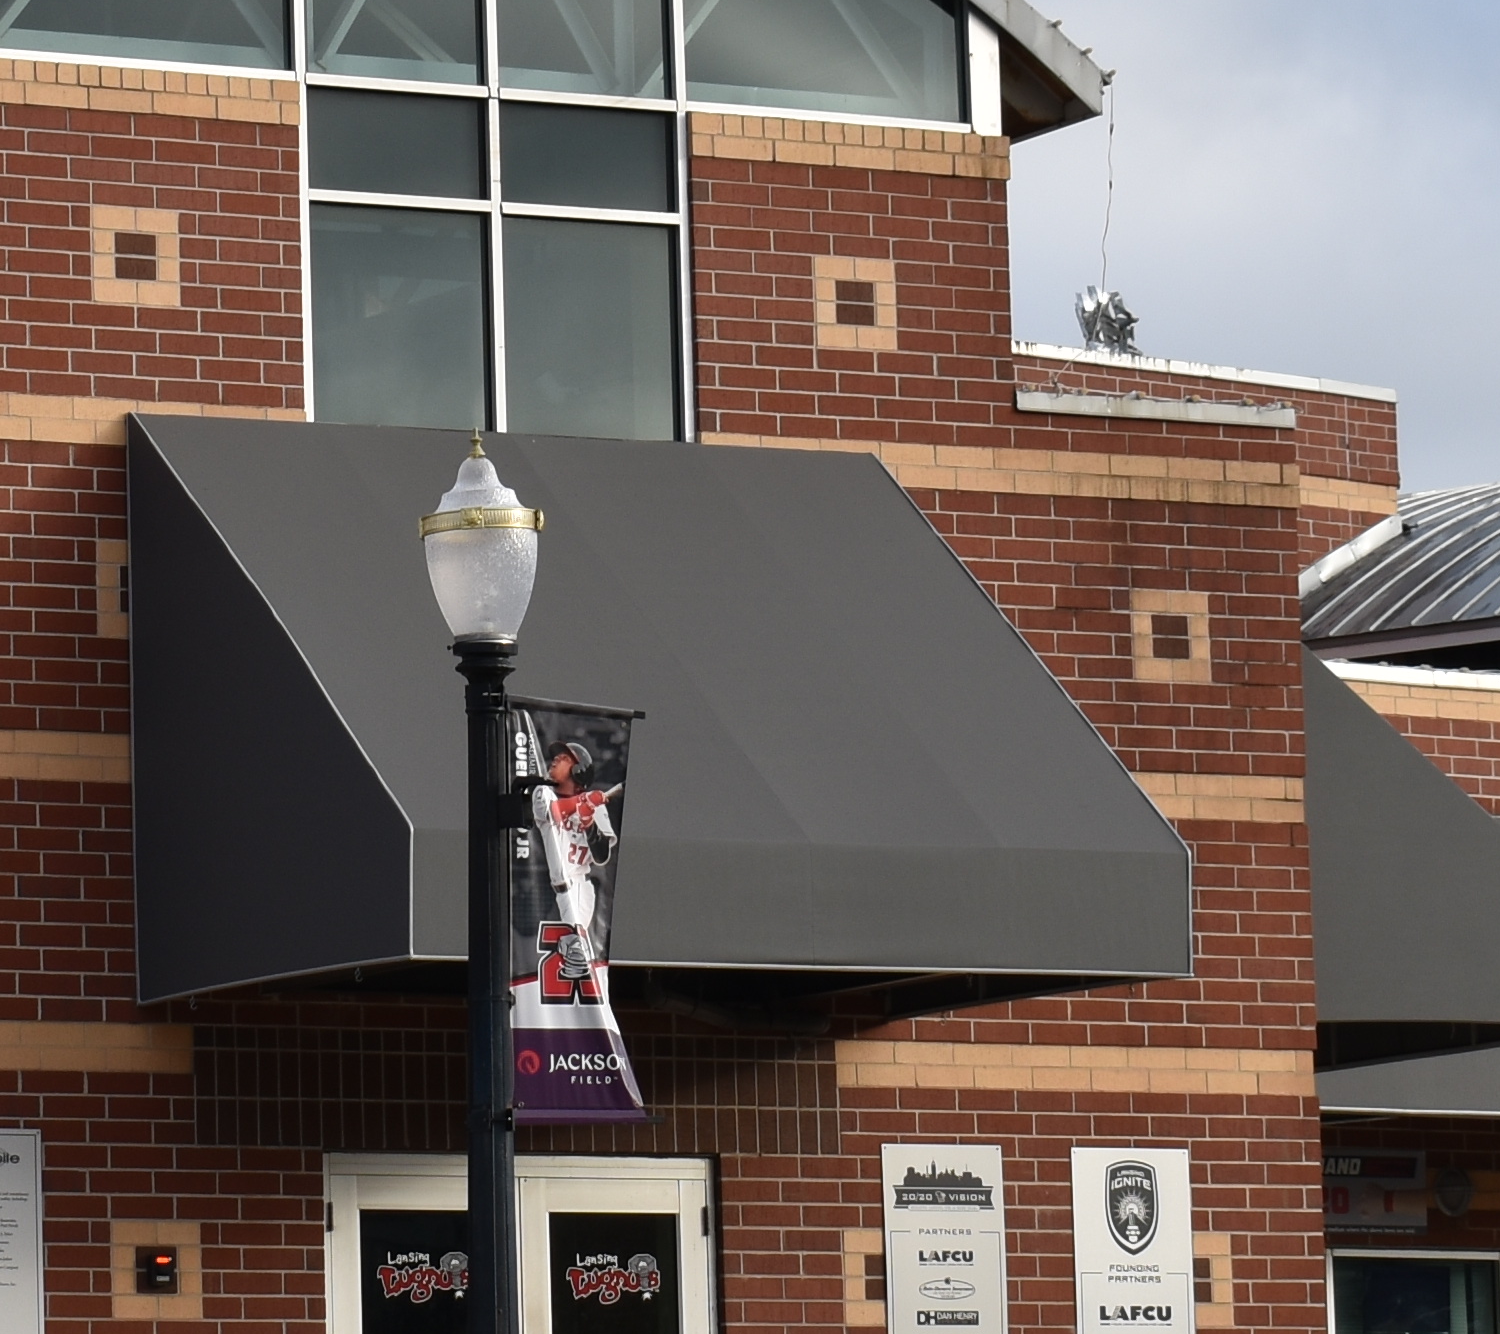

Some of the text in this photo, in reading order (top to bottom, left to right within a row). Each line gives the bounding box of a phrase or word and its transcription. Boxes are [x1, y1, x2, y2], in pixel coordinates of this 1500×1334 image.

[567, 843, 589, 865] 27
[570, 1075, 612, 1085] FIELD
[1110, 1176, 1152, 1191] IGNITE
[902, 1193, 986, 1202] 20/20 VISION
[918, 1228, 972, 1236] PARTNERS
[387, 1251, 430, 1267] Lansing
[576, 1253, 618, 1269] Lansing
[918, 1250, 974, 1263] LAFCU
[1109, 1264, 1160, 1273] FOUNDING
[1107, 1275, 1162, 1283] PARTNERS
[1099, 1305, 1172, 1322] LAFCU
